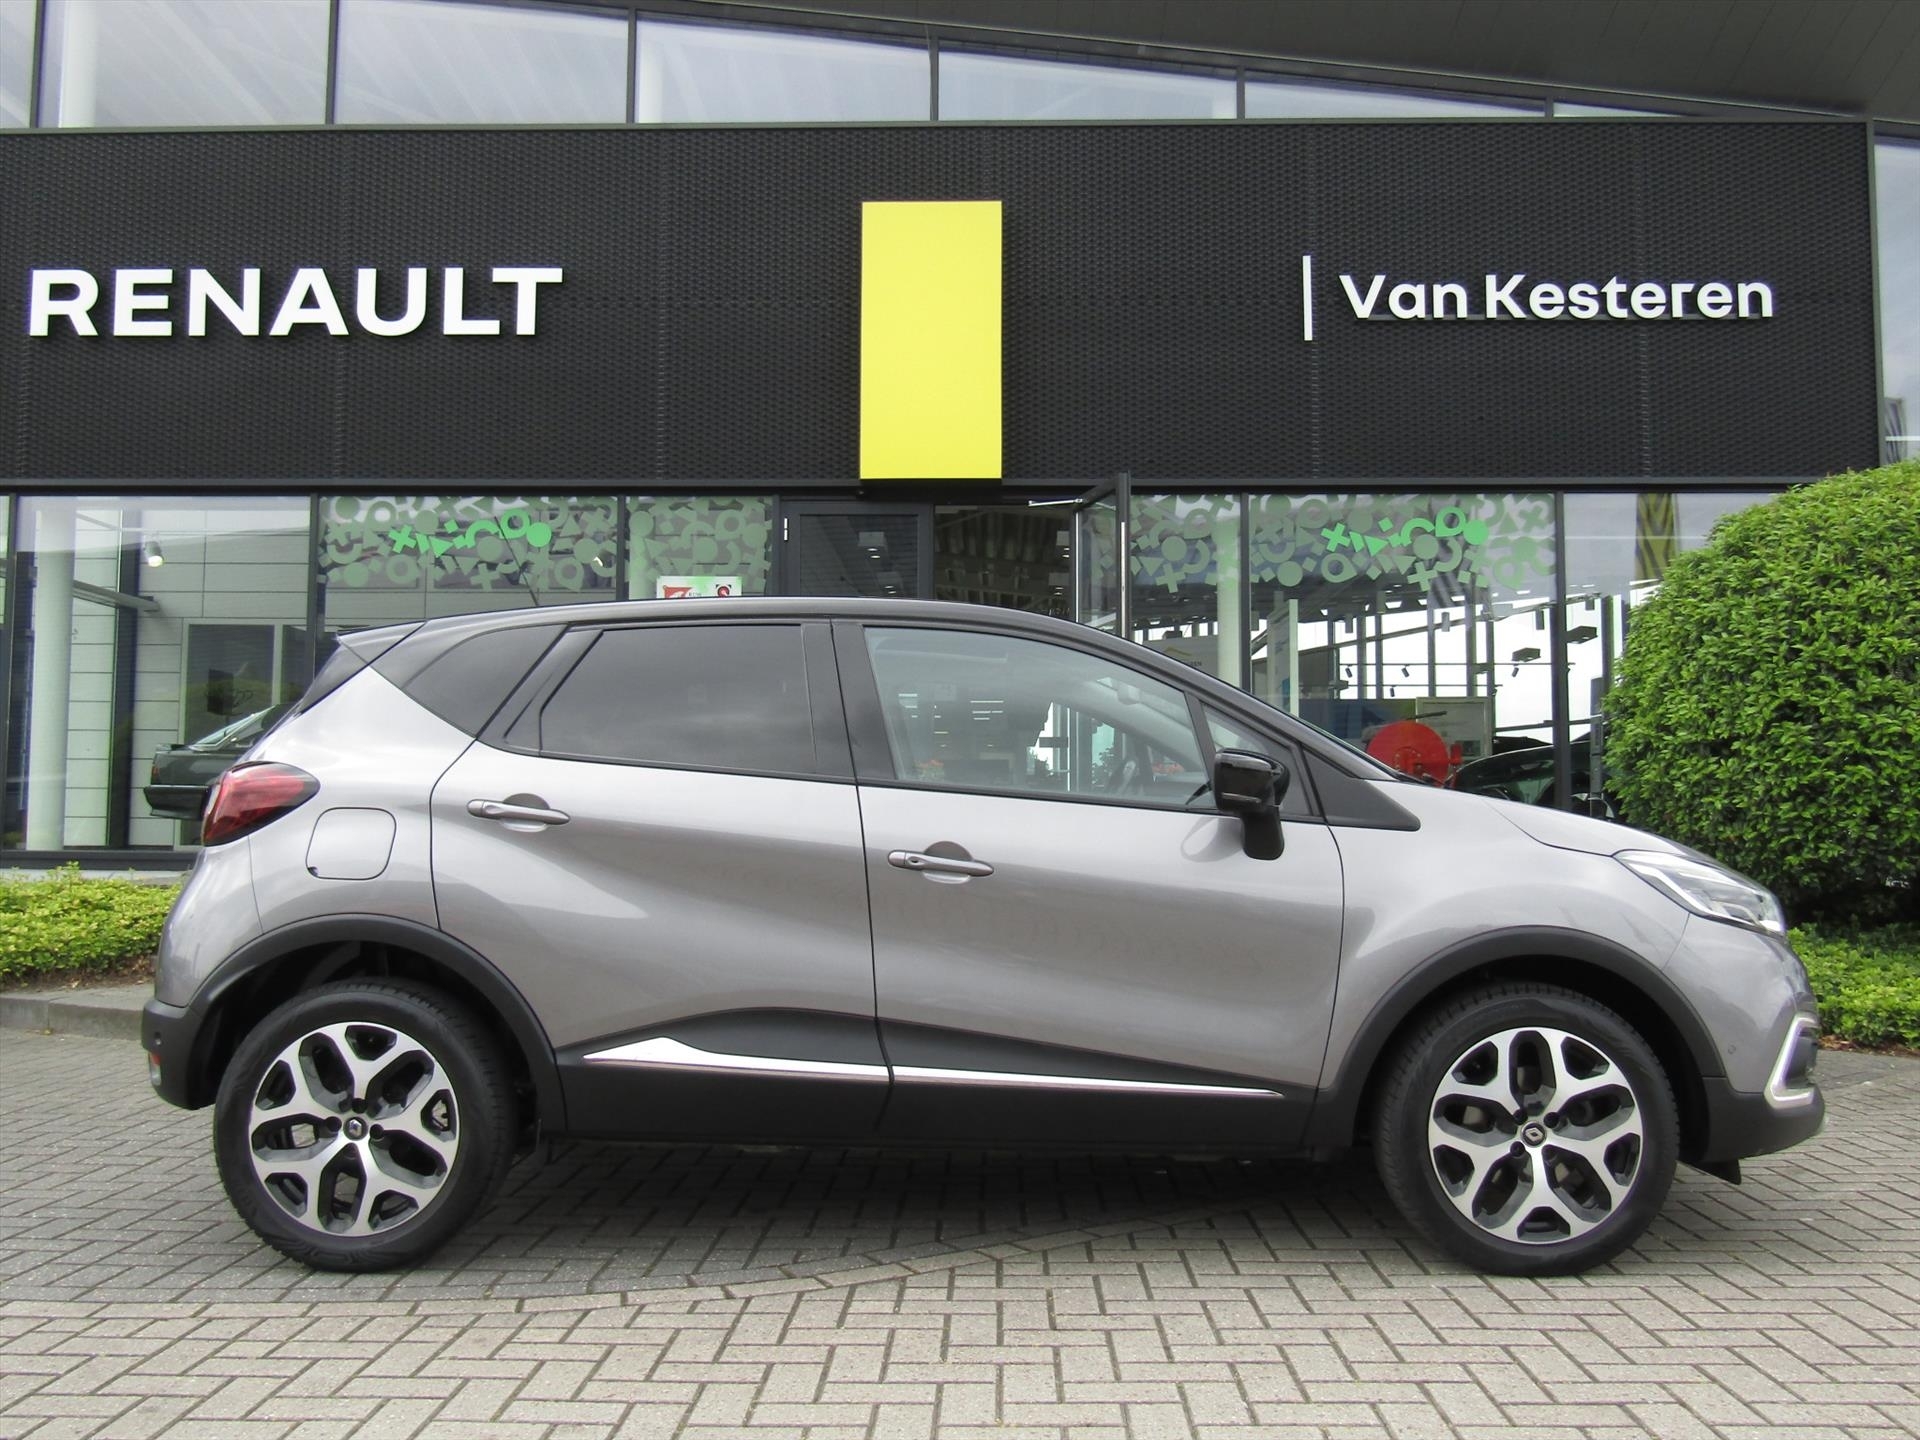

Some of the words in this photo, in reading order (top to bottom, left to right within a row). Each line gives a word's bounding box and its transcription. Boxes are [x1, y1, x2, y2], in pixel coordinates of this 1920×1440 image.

[28, 267, 563, 337] RENAULT
[1339, 274, 1467, 319] Van
[1485, 274, 1773, 319] Kesteren
